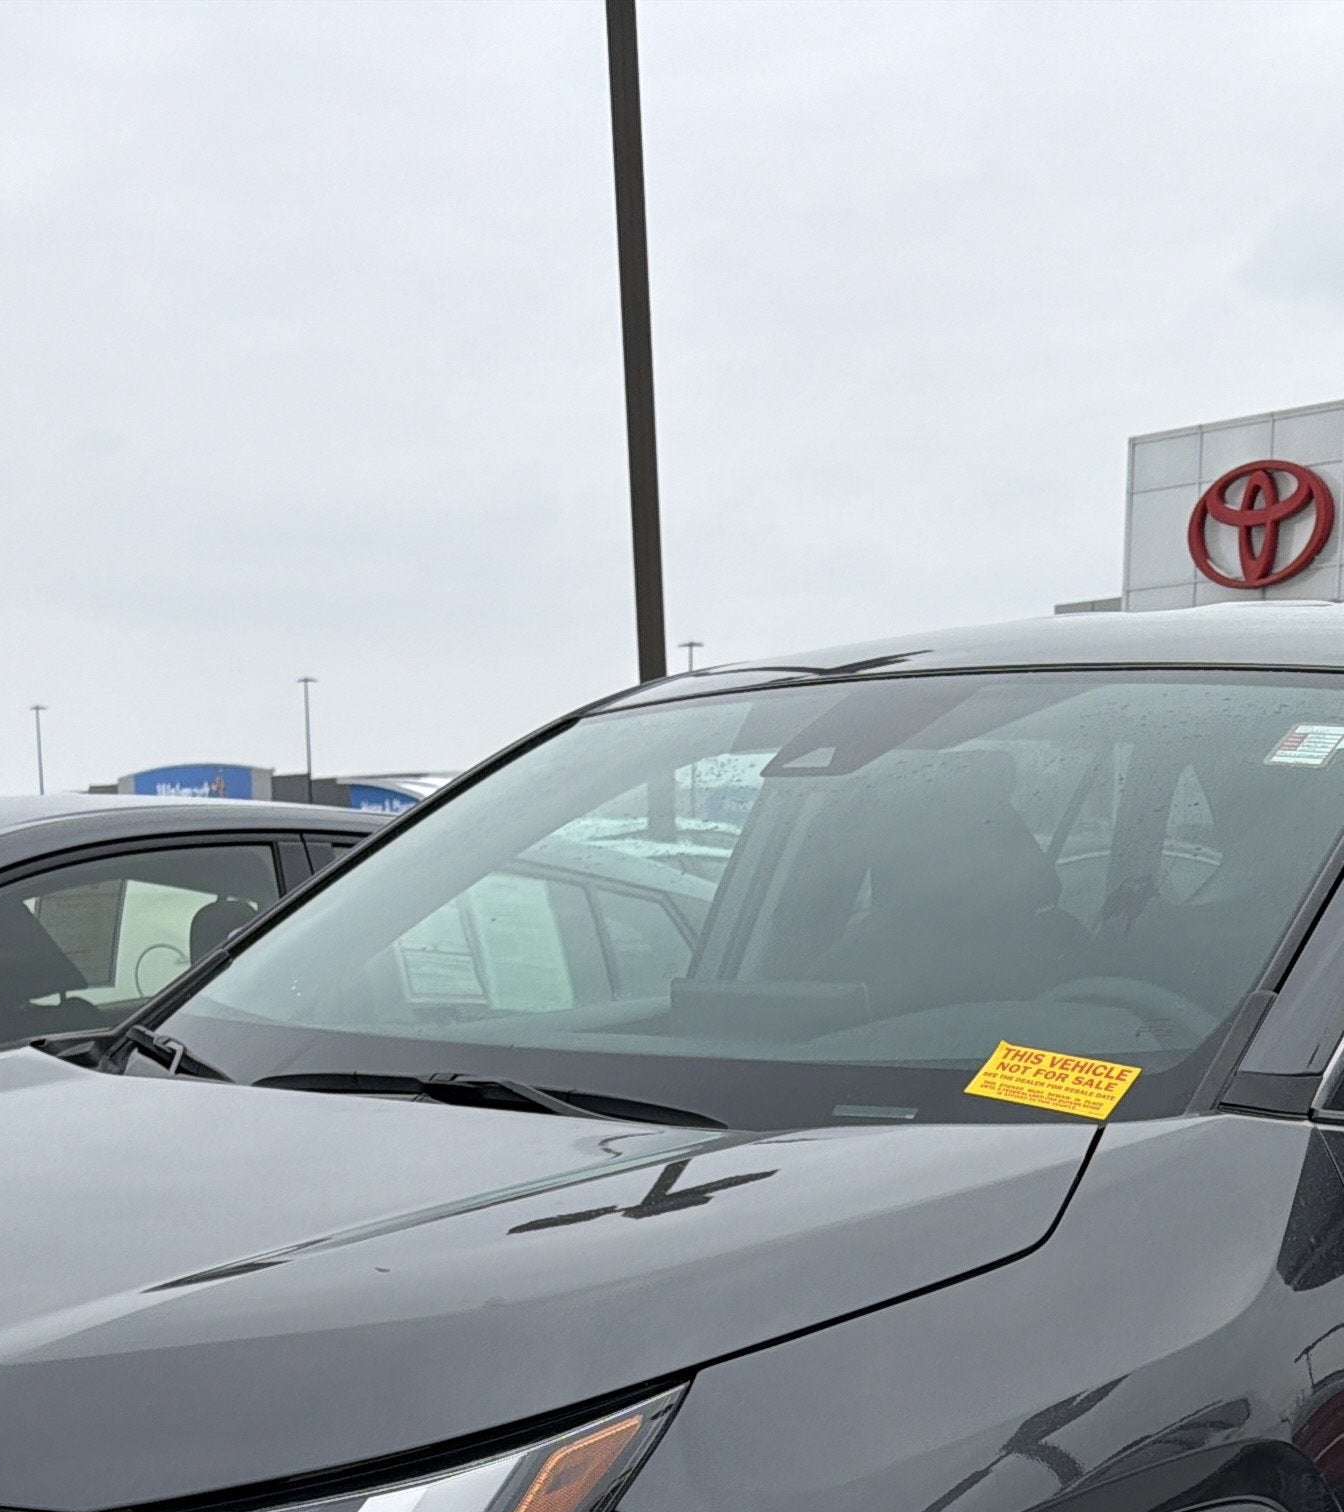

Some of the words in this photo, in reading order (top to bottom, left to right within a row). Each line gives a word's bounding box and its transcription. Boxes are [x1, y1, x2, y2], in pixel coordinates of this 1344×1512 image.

[995, 1061, 1033, 1075] NOT
[1032, 1068, 1070, 1083] FOR
[1071, 1076, 1118, 1092] SALE
[1001, 1047, 1046, 1065] THIS
[1049, 1056, 1133, 1082] VEHICLE
[1015, 1077, 1045, 1087] DEALER
[1046, 1083, 1063, 1091] FOR
[1064, 1086, 1095, 1097] RESALE
[1094, 1092, 1116, 1101] DATE
